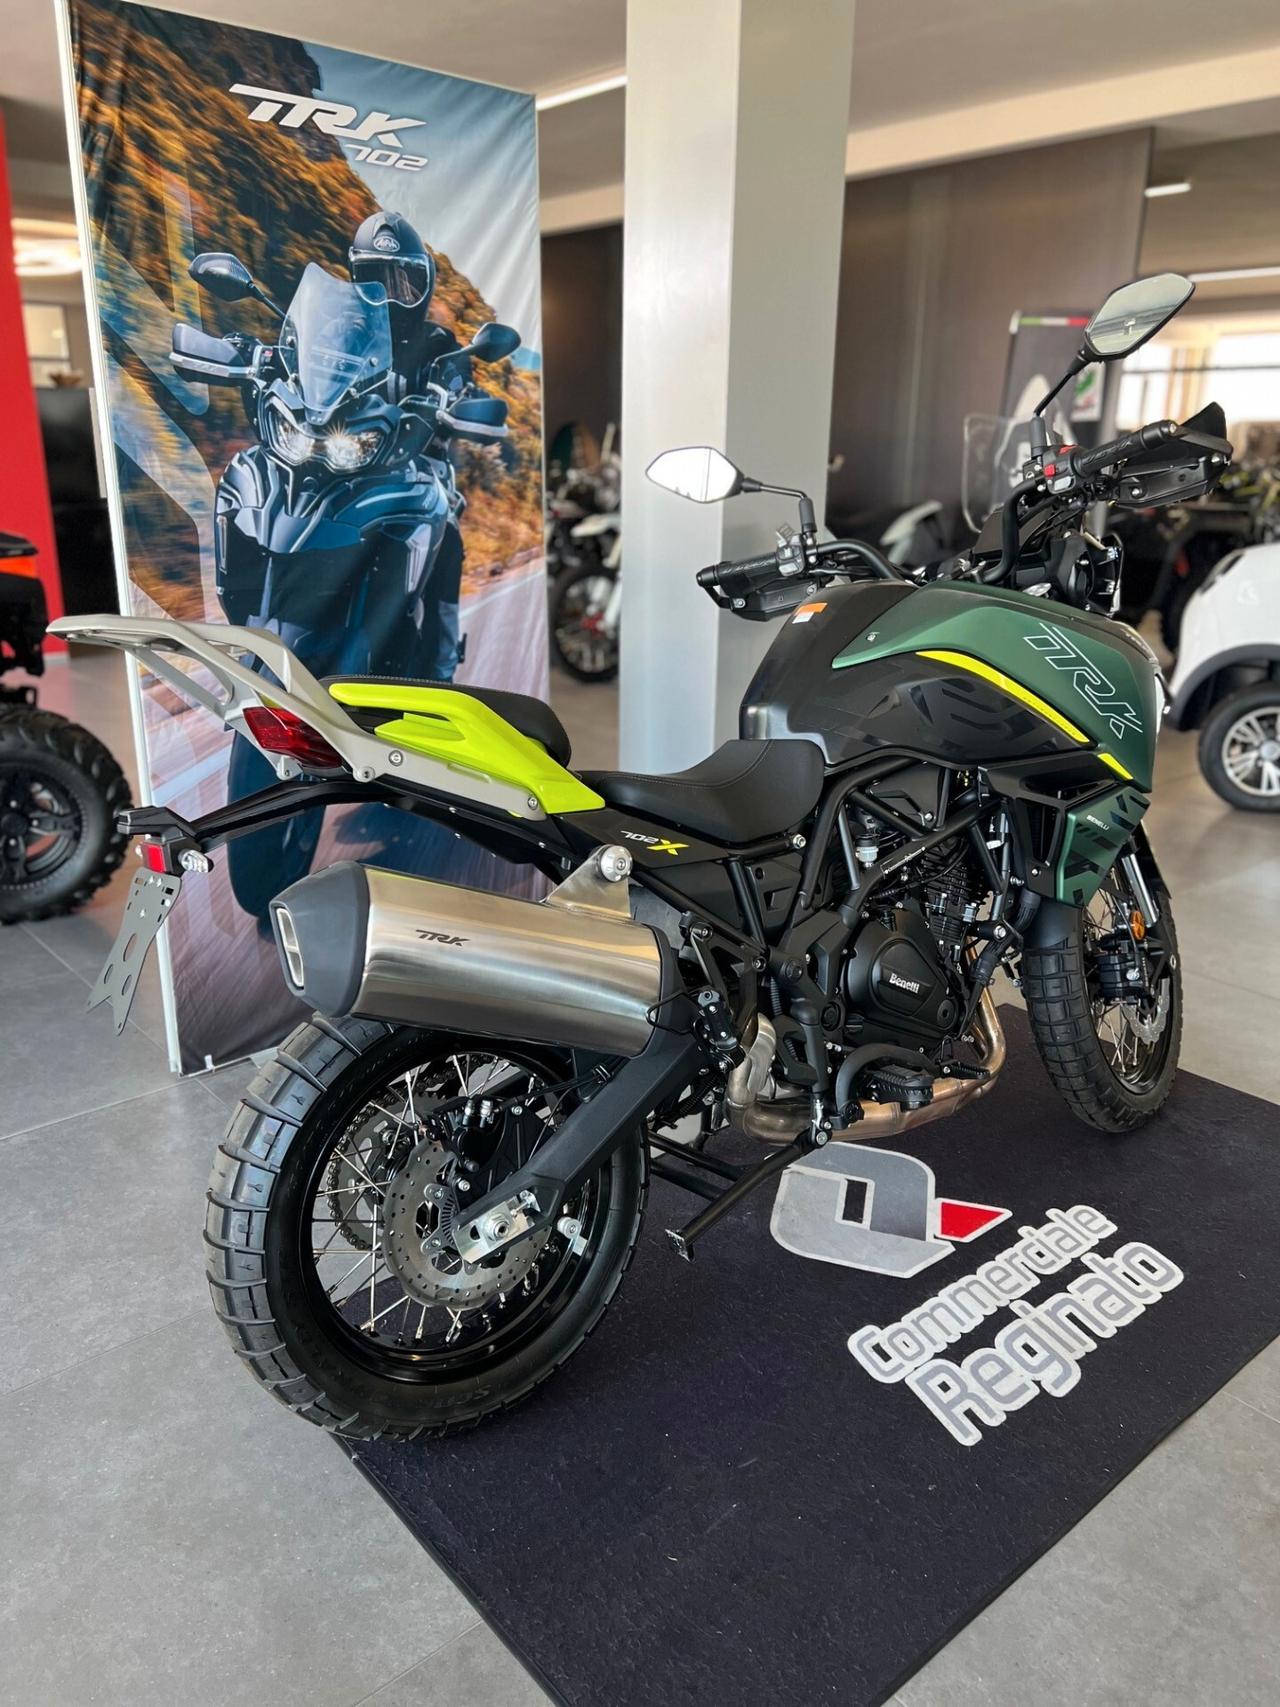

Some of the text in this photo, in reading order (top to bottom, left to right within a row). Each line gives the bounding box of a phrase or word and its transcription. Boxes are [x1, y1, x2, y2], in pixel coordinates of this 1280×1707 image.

[229, 83, 427, 148] TRK
[344, 144, 429, 171] 702
[1023, 622, 1143, 739] TRK
[415, 929, 471, 947] TRK
[889, 972, 920, 994] Benelli
[851, 1206, 1114, 1380] Commerciale
[909, 1244, 1179, 1442] Reginato
